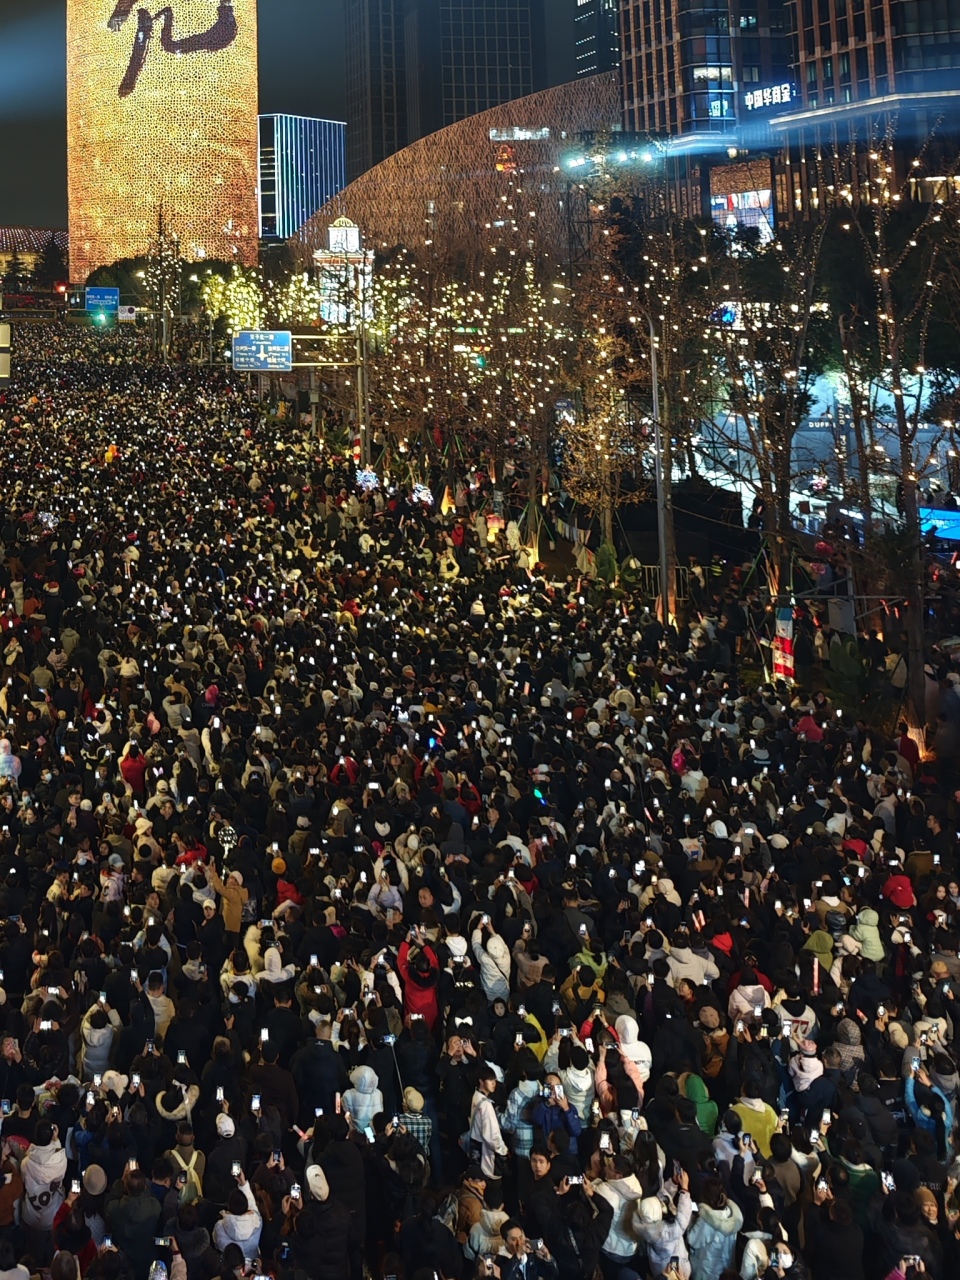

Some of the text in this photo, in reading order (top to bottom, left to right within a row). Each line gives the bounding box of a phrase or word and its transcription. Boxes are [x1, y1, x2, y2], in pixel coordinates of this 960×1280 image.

[744, 83, 796, 111] 中国华商金
